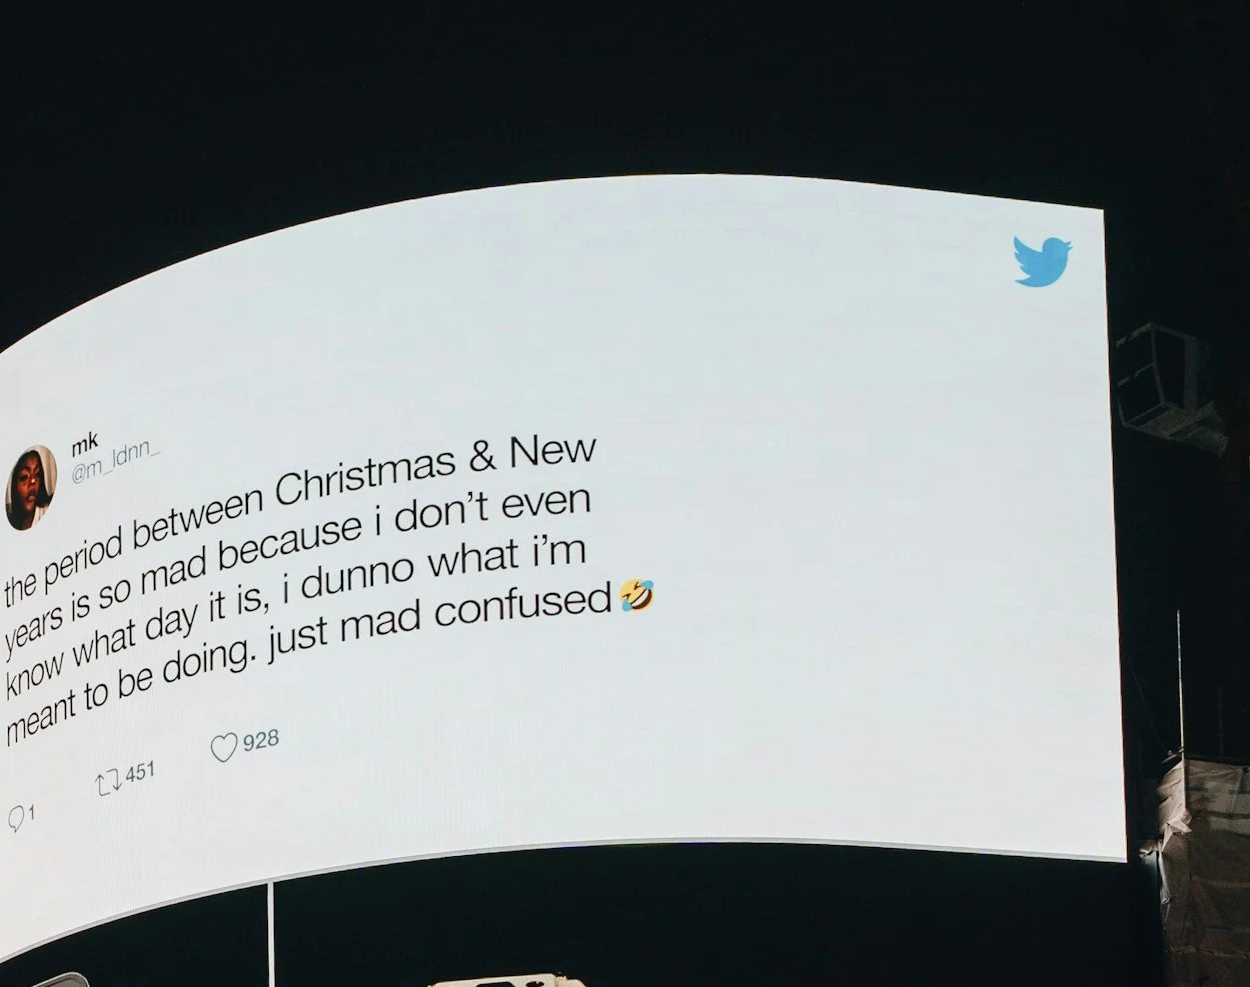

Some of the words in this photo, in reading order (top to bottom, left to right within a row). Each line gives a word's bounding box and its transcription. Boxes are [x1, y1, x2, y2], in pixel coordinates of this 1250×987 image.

[71, 431, 99, 458] mk
[71, 438, 161, 485] @m_ldnn_
[3, 572, 37, 609] the
[44, 524, 123, 596] period
[133, 489, 263, 551] between
[275, 451, 457, 506] Christmas
[468, 439, 498, 473] &
[510, 433, 598, 469] New
[4, 606, 64, 664] years
[71, 591, 91, 623] is
[98, 578, 132, 610] so
[141, 544, 207, 596] mad
[218, 516, 363, 572] because
[374, 504, 382, 537] i
[501, 488, 591, 519] even
[6, 651, 65, 702] know
[71, 618, 137, 668] what
[145, 603, 199, 641] day
[209, 590, 226, 623] it
[237, 583, 270, 616] is,
[282, 572, 290, 605] i
[301, 557, 415, 600] dunno
[426, 538, 520, 578] what
[6, 688, 77, 748] meant
[83, 682, 109, 711] to
[118, 667, 154, 700] be
[162, 639, 257, 684] doing.
[267, 615, 329, 666] just
[340, 597, 421, 643] mad
[434, 580, 611, 627] confused
[243, 729, 280, 752] 928
[125, 760, 155, 784] 451
[28, 804, 36, 821] 1
